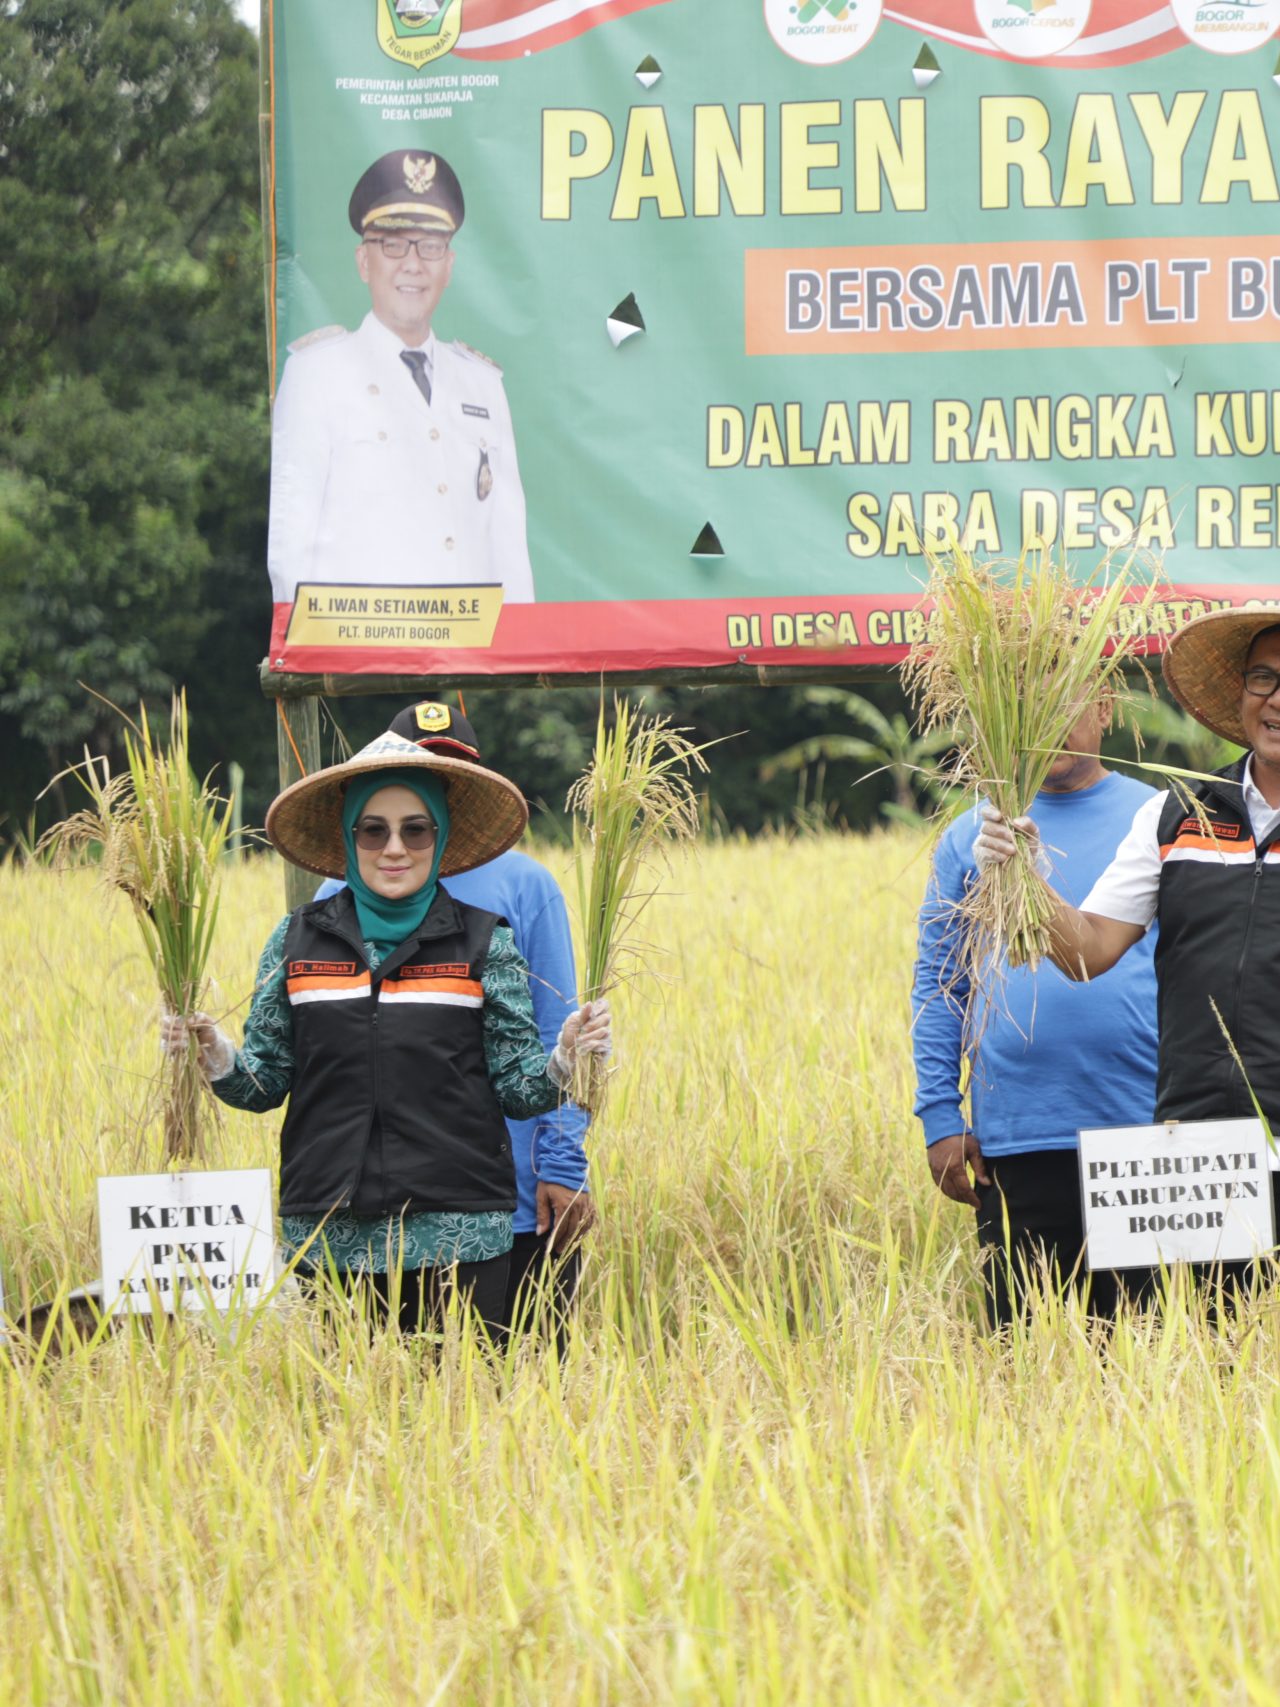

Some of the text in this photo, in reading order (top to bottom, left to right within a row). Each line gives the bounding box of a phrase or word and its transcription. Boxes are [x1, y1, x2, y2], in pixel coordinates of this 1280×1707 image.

[787, 23, 859, 35] BOGOR SEHAT
[992, 17, 1029, 28] BOGOR
[386, 30, 452, 61] TEGAR BERIMAN
[336, 75, 499, 91] PEMERINTAH KABUPATEN BOGOR
[360, 90, 473, 105] KECAMATAN SUKARAJA
[382, 107, 452, 120] DESA CIBANON
[540, 97, 927, 221] PANEN
[980, 89, 1280, 210] RAYA
[785, 262, 1087, 333] BERSAMA
[1105, 258, 1211, 327] PLT
[705, 400, 911, 469] DALAM
[932, 393, 1177, 464] RANGKA
[846, 489, 1003, 559] SABA
[1020, 486, 1178, 552] DESA
[308, 598, 480, 616] H. IWAN SETIAWAN, S.E
[338, 625, 450, 640] PLT. BUPATI BOGOR
[727, 614, 762, 650] DI
[771, 610, 860, 649] DESA
[1090, 1181, 1259, 1208] KABUPATEN
[128, 1204, 246, 1230] KETUA
[1129, 1211, 1223, 1233] BOGOR
[151, 1241, 226, 1265] PKK
